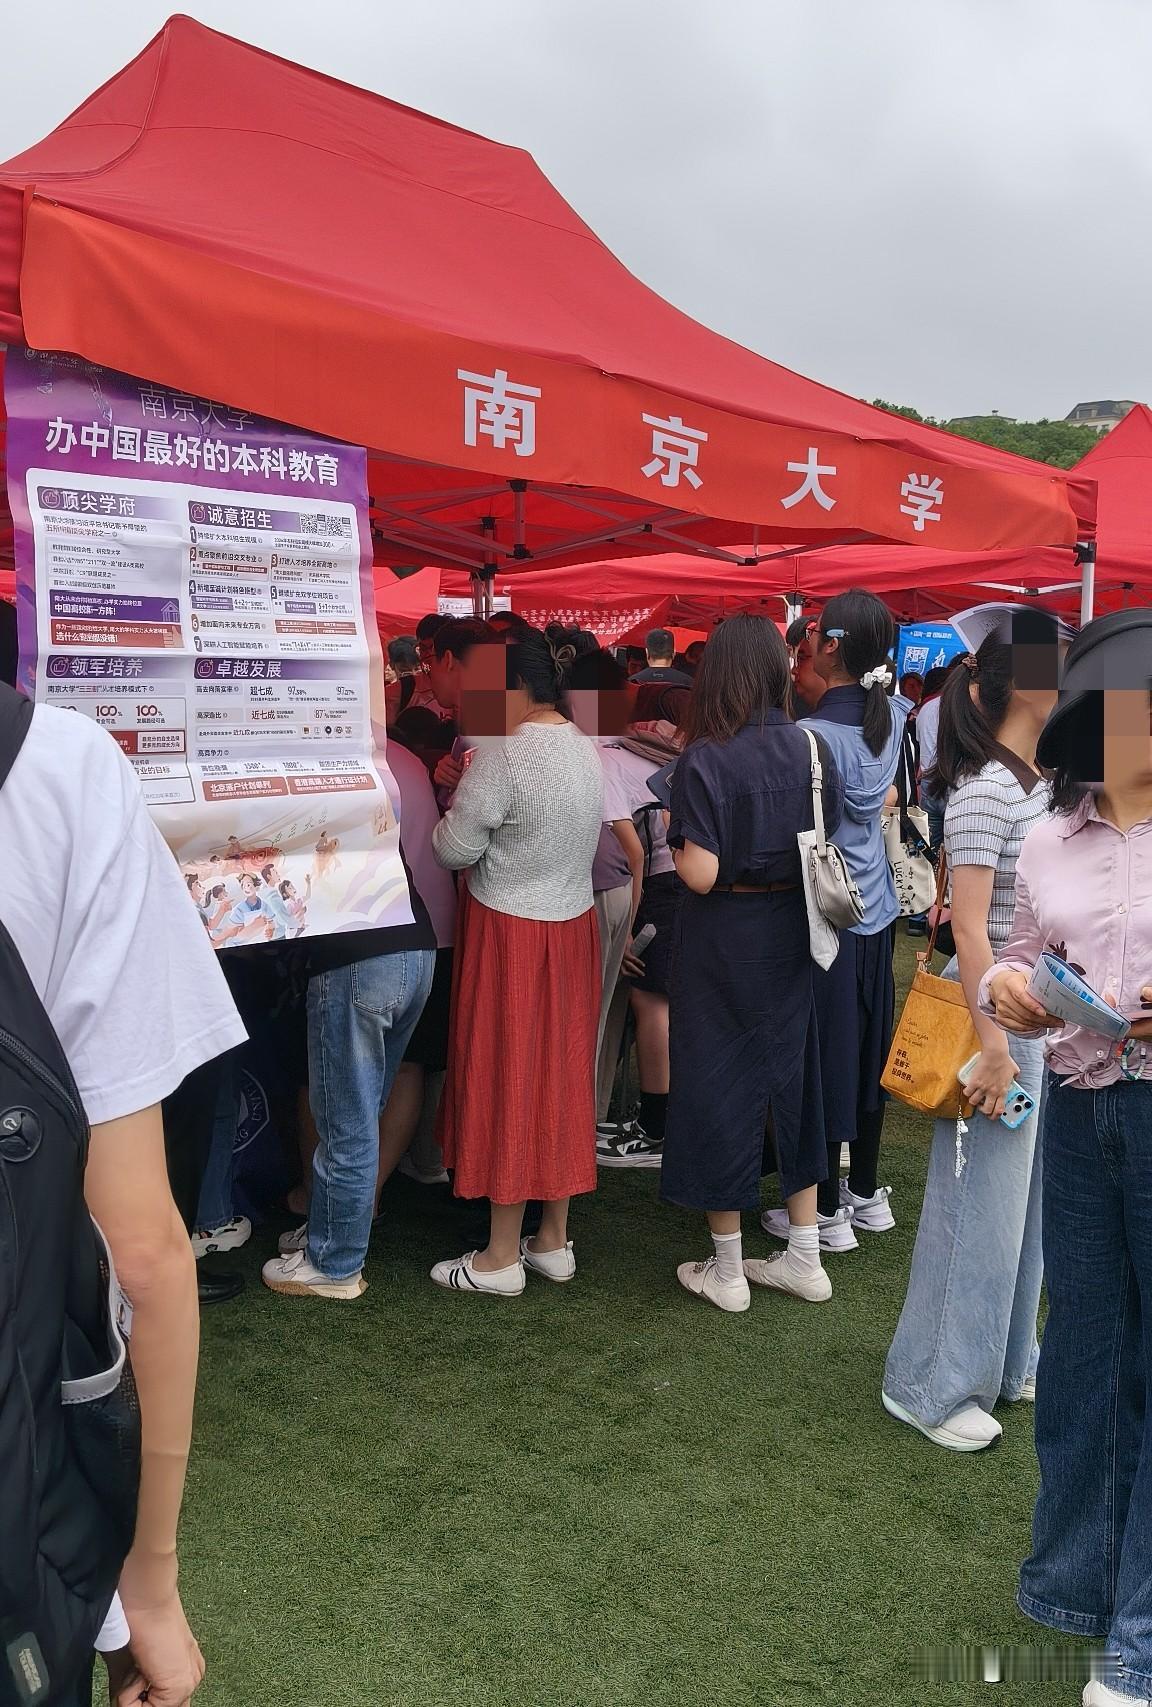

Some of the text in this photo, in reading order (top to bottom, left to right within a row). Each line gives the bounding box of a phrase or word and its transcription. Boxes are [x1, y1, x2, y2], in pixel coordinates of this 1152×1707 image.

[137, 385, 255, 431] 南京大学
[45, 416, 340, 487] 办中国最好的本科教育
[457, 368, 945, 532] 南京大学
[61, 491, 136, 516] 顶尖学府
[208, 506, 273, 530] 诚意招生
[70, 657, 143, 677] 领军培养
[216, 660, 282, 678] 卓越发展
[250, 686, 273, 696] 超七成
[251, 710, 276, 720] 近七成
[893, 861, 905, 890] LUCKY
